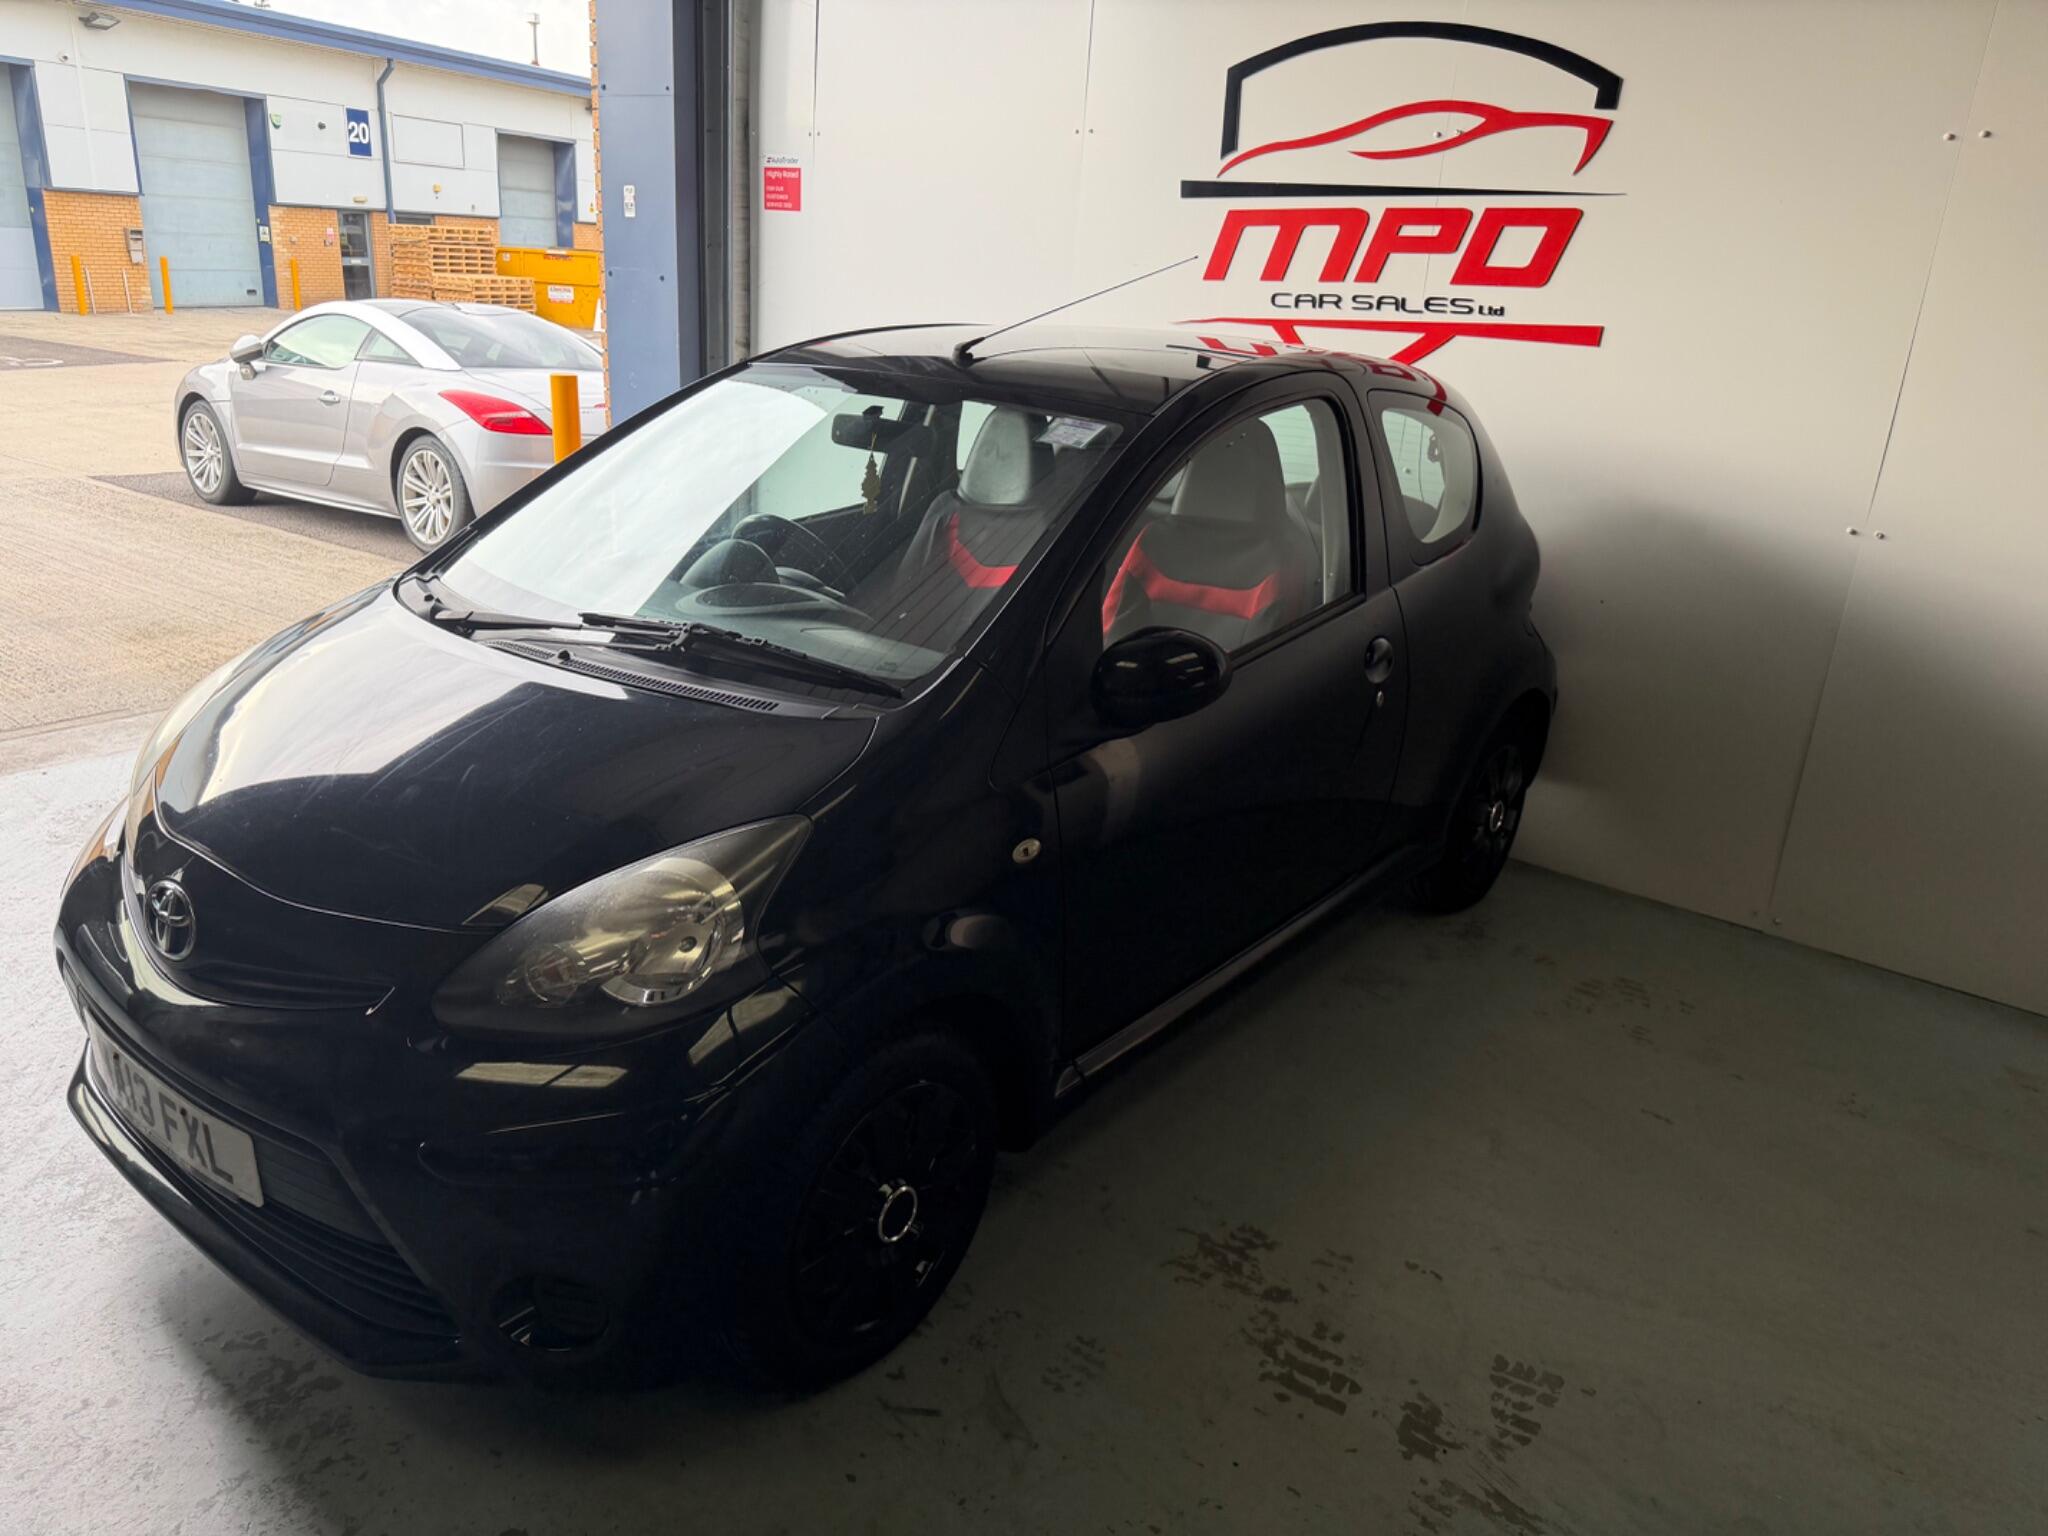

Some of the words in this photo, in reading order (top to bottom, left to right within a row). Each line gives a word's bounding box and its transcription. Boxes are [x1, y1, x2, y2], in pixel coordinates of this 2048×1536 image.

[349, 121, 369, 144] 20
[1203, 207, 1584, 288] MPD
[1271, 292, 1342, 310] CAR
[1351, 294, 1475, 315] SALES
[1478, 304, 1505, 317] Ltd
[158, 1091, 234, 1186] FXL
